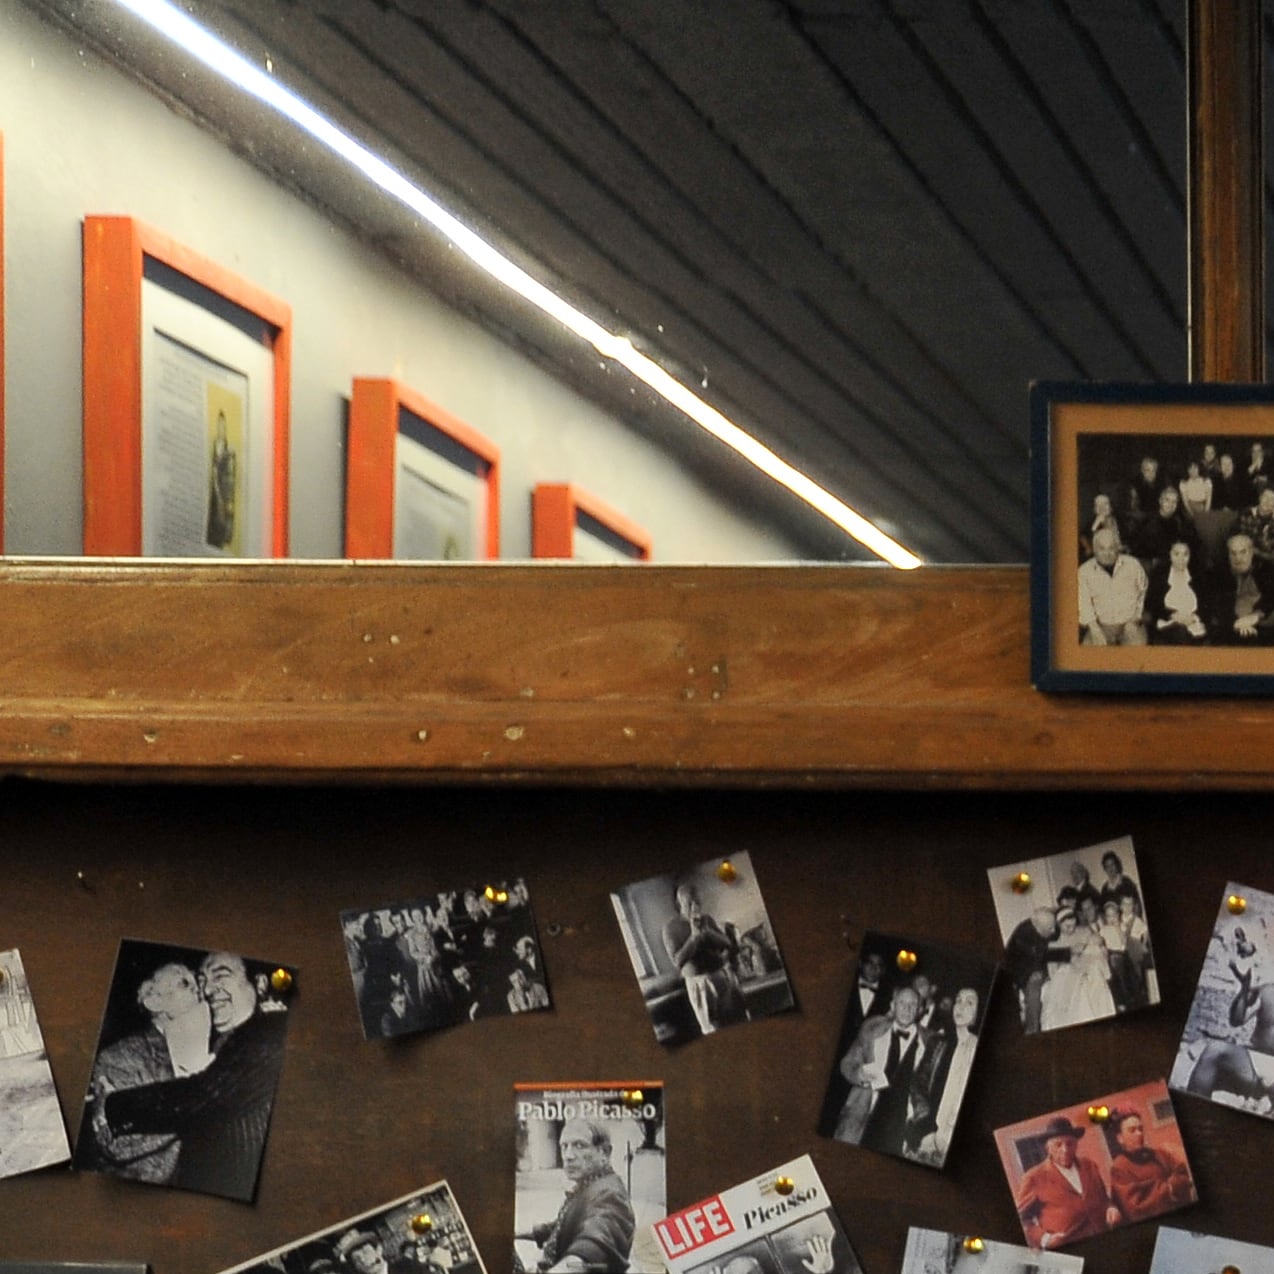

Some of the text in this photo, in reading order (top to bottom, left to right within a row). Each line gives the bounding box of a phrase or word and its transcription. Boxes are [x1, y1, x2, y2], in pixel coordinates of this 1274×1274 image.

[518, 1099, 656, 1122] Pablo Picasso
[657, 1186, 818, 1257] LIFE Picasso
